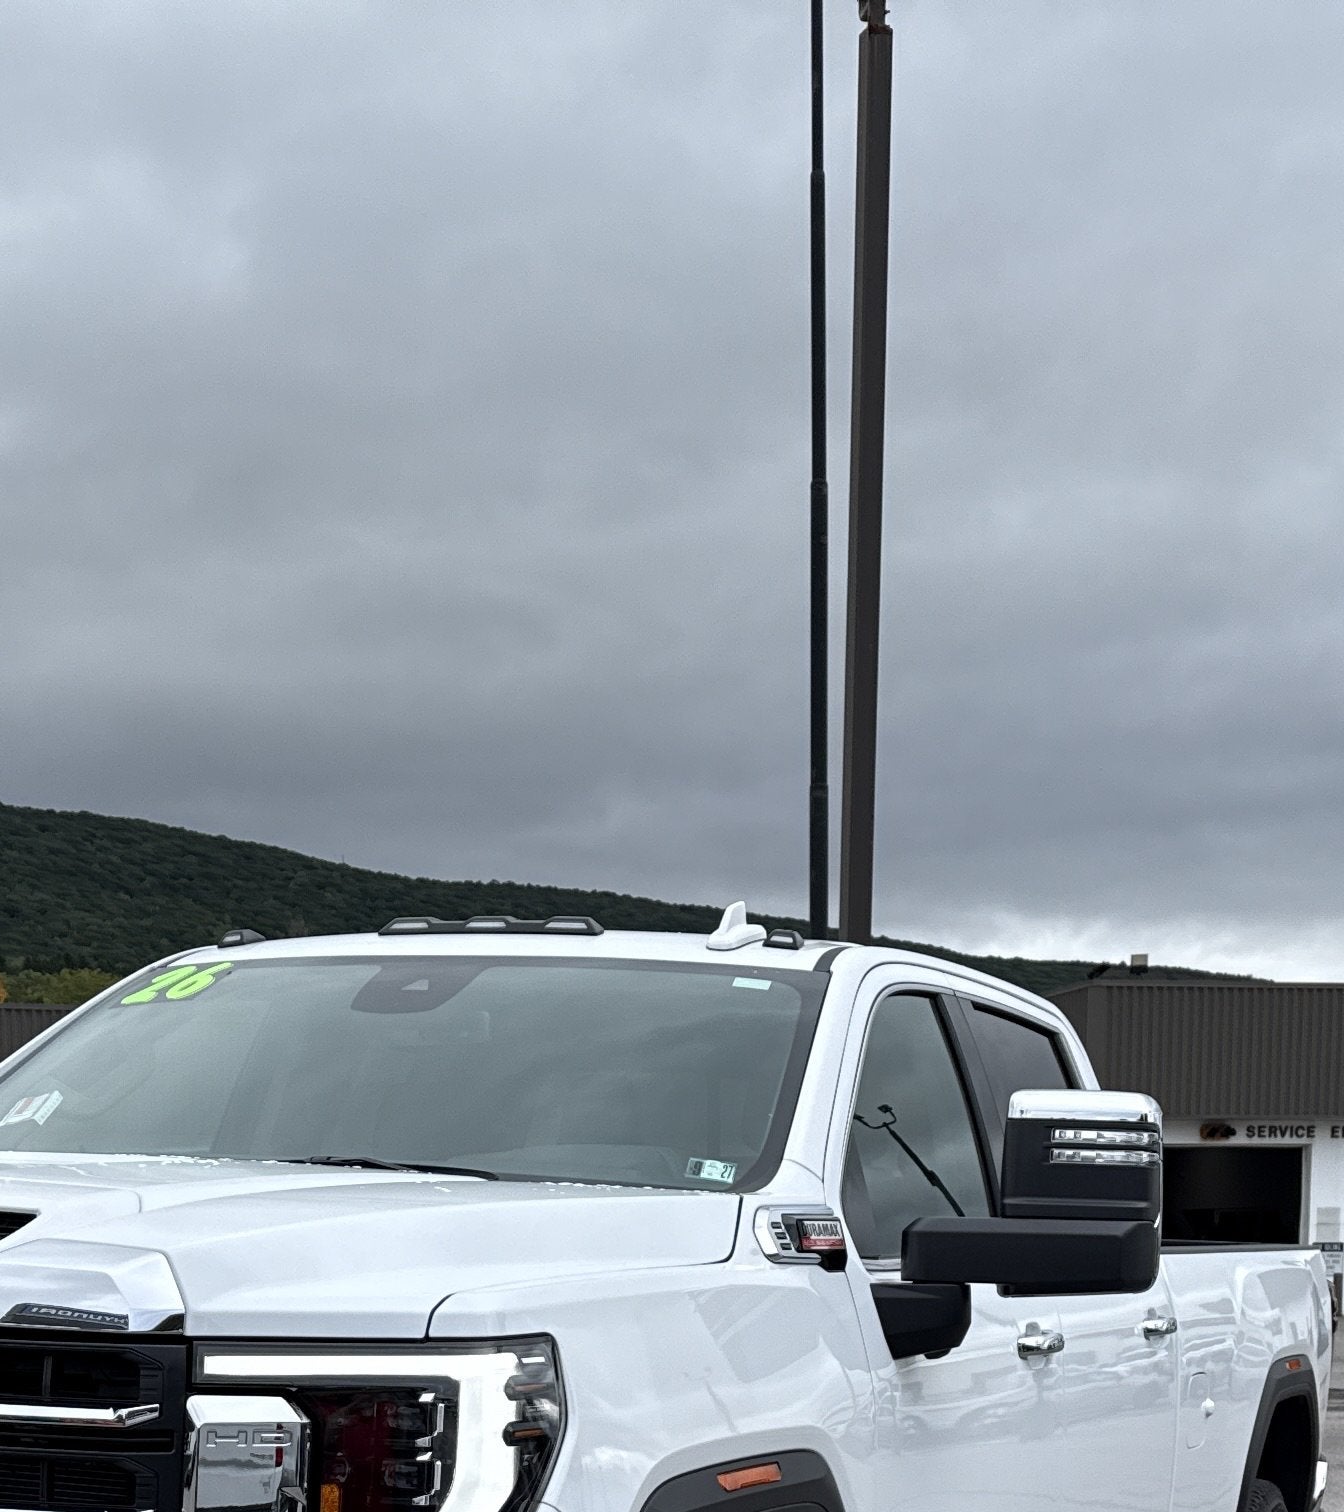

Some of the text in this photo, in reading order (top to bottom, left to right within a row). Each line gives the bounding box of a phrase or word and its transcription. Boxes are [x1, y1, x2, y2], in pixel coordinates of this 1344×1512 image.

[120, 961, 234, 1006] 26
[1245, 1125, 1317, 1139] SERVICE
[720, 1164, 734, 1180] 27
[802, 1222, 841, 1237] DURAMAX
[206, 1429, 294, 1448] HD
